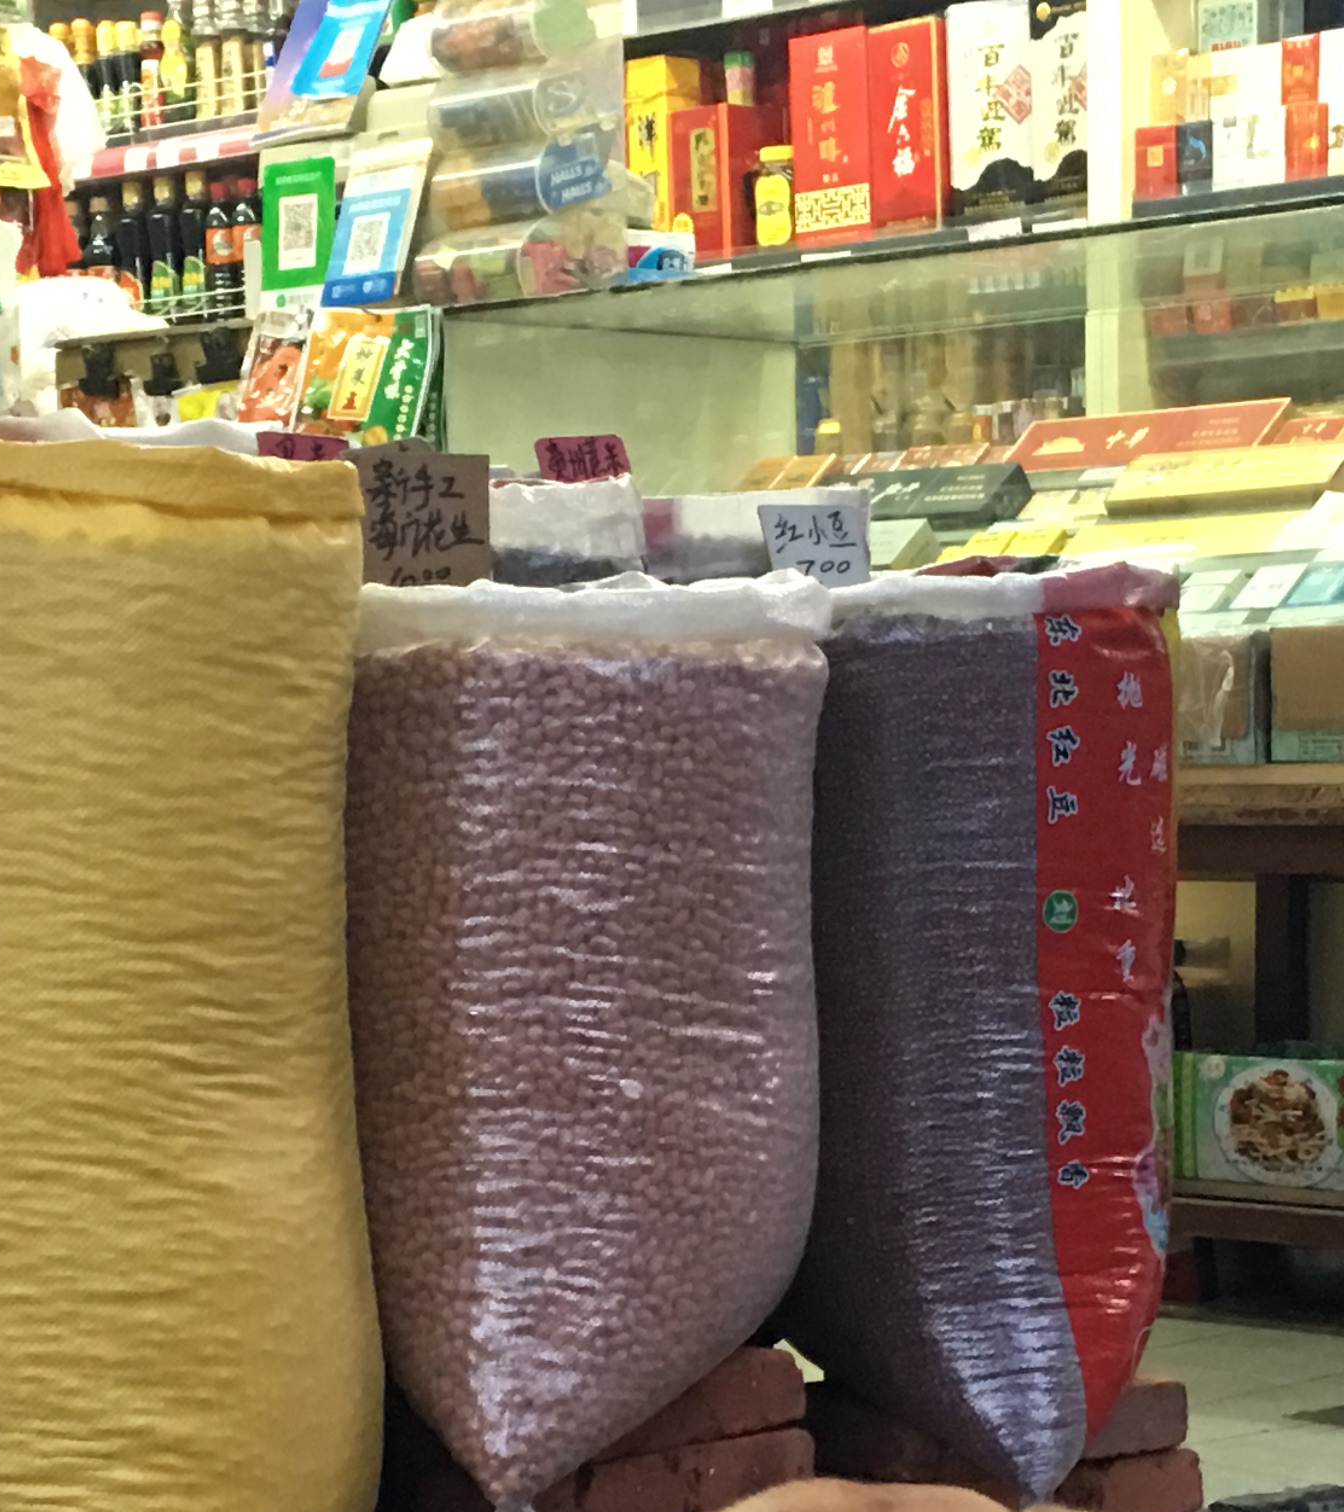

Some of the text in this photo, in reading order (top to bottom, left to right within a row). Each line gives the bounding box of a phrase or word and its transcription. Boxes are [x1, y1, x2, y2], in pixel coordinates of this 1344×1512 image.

[774, 510, 857, 554] 红小豆
[1044, 614, 1083, 824] 东北红豆
[1049, 990, 1090, 1190] 粒粒飘香
